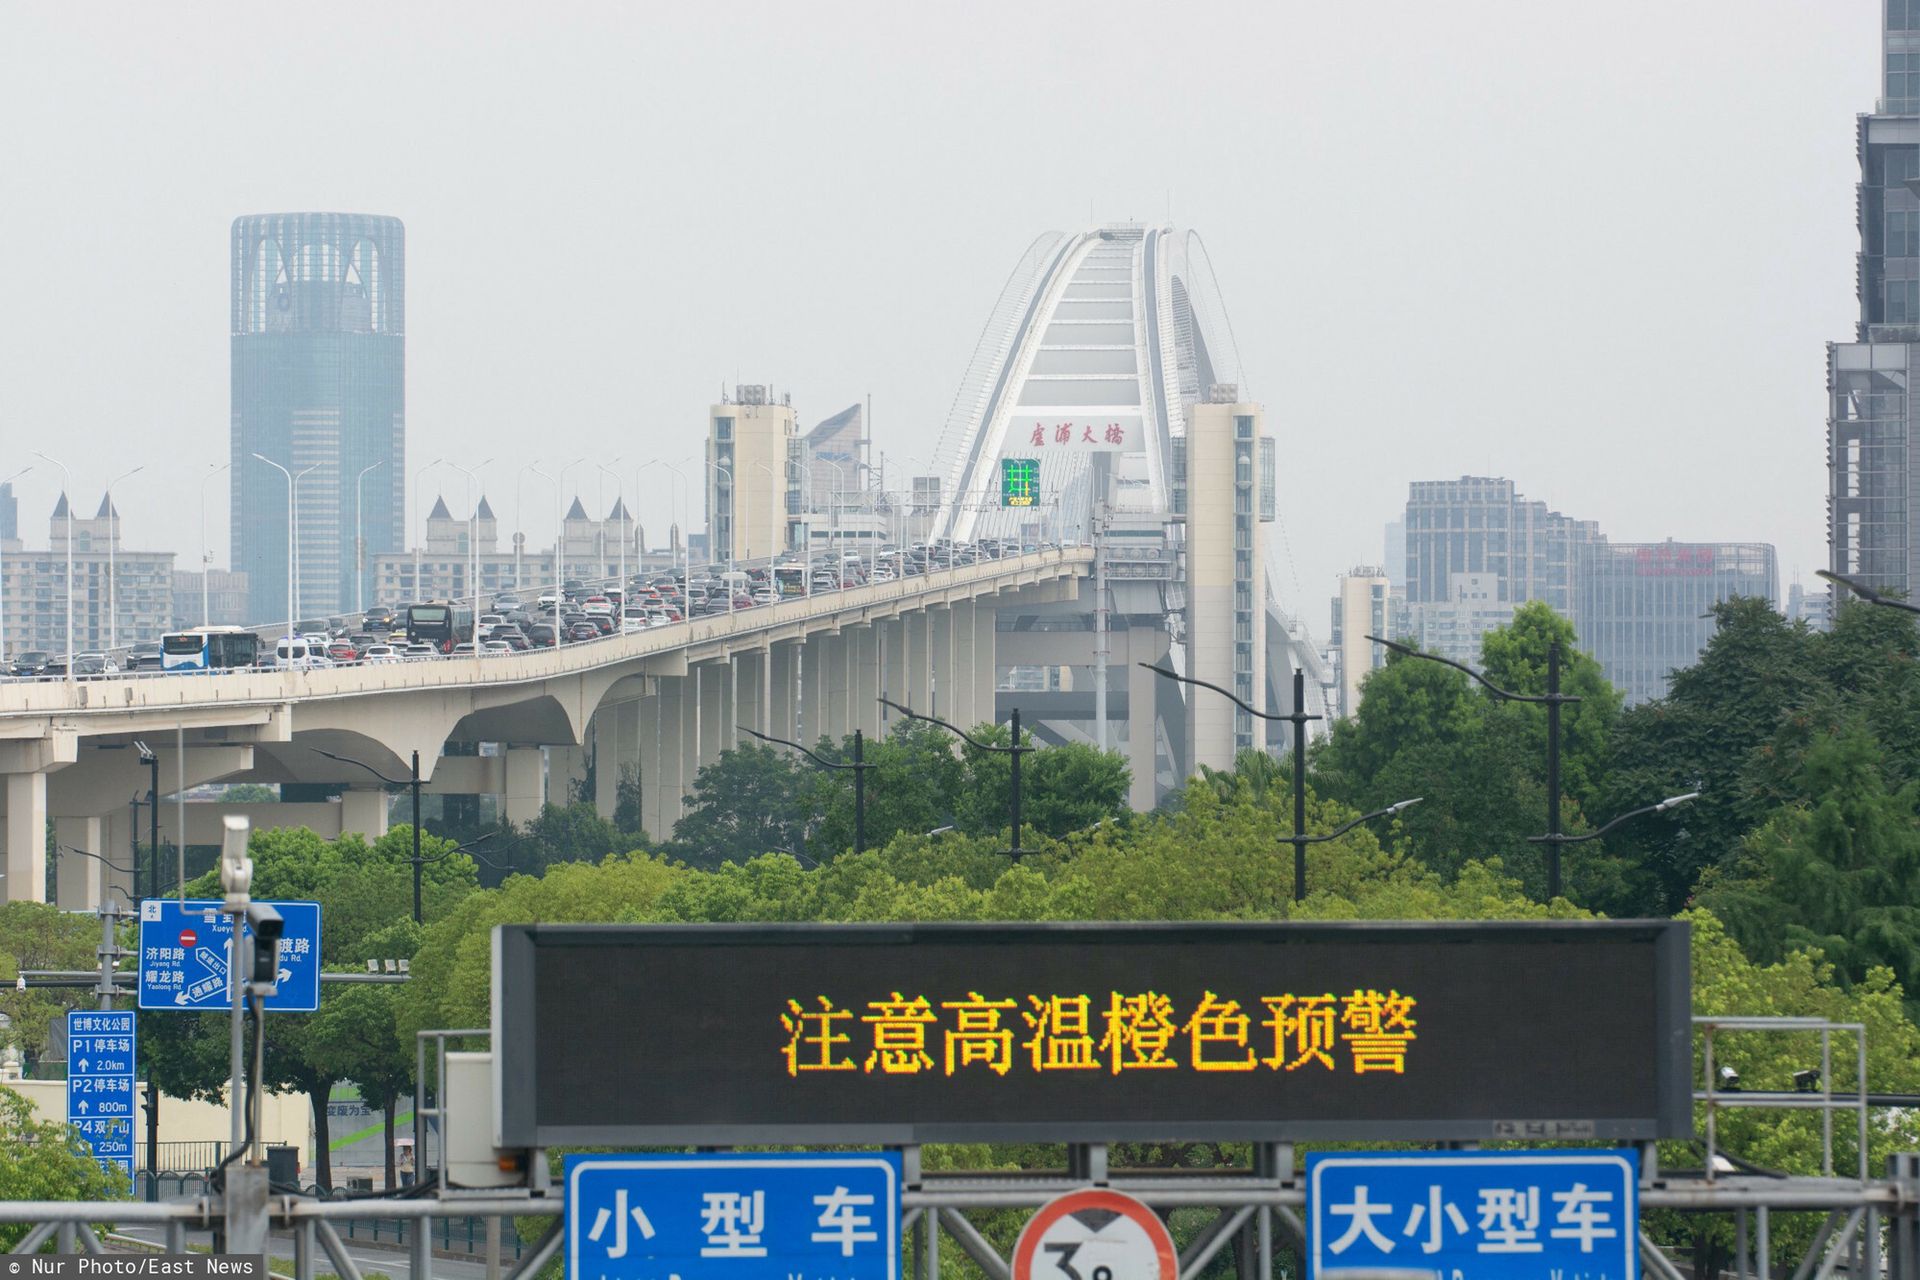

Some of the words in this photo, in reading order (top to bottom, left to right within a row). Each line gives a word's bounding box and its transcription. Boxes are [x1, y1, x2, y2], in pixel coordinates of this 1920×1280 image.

[146, 947, 185, 960] 济阳路
[145, 971, 185, 984] 耀龙路
[73, 1017, 131, 1031] 世博文化公园
[780, 990, 1418, 1077] 注意高温橙色预警
[96, 1060, 125, 1071] 2.0km
[98, 1102, 128, 1112] 800m
[98, 1141, 128, 1152] 250m
[1327, 1182, 1617, 1255] 大小型车
